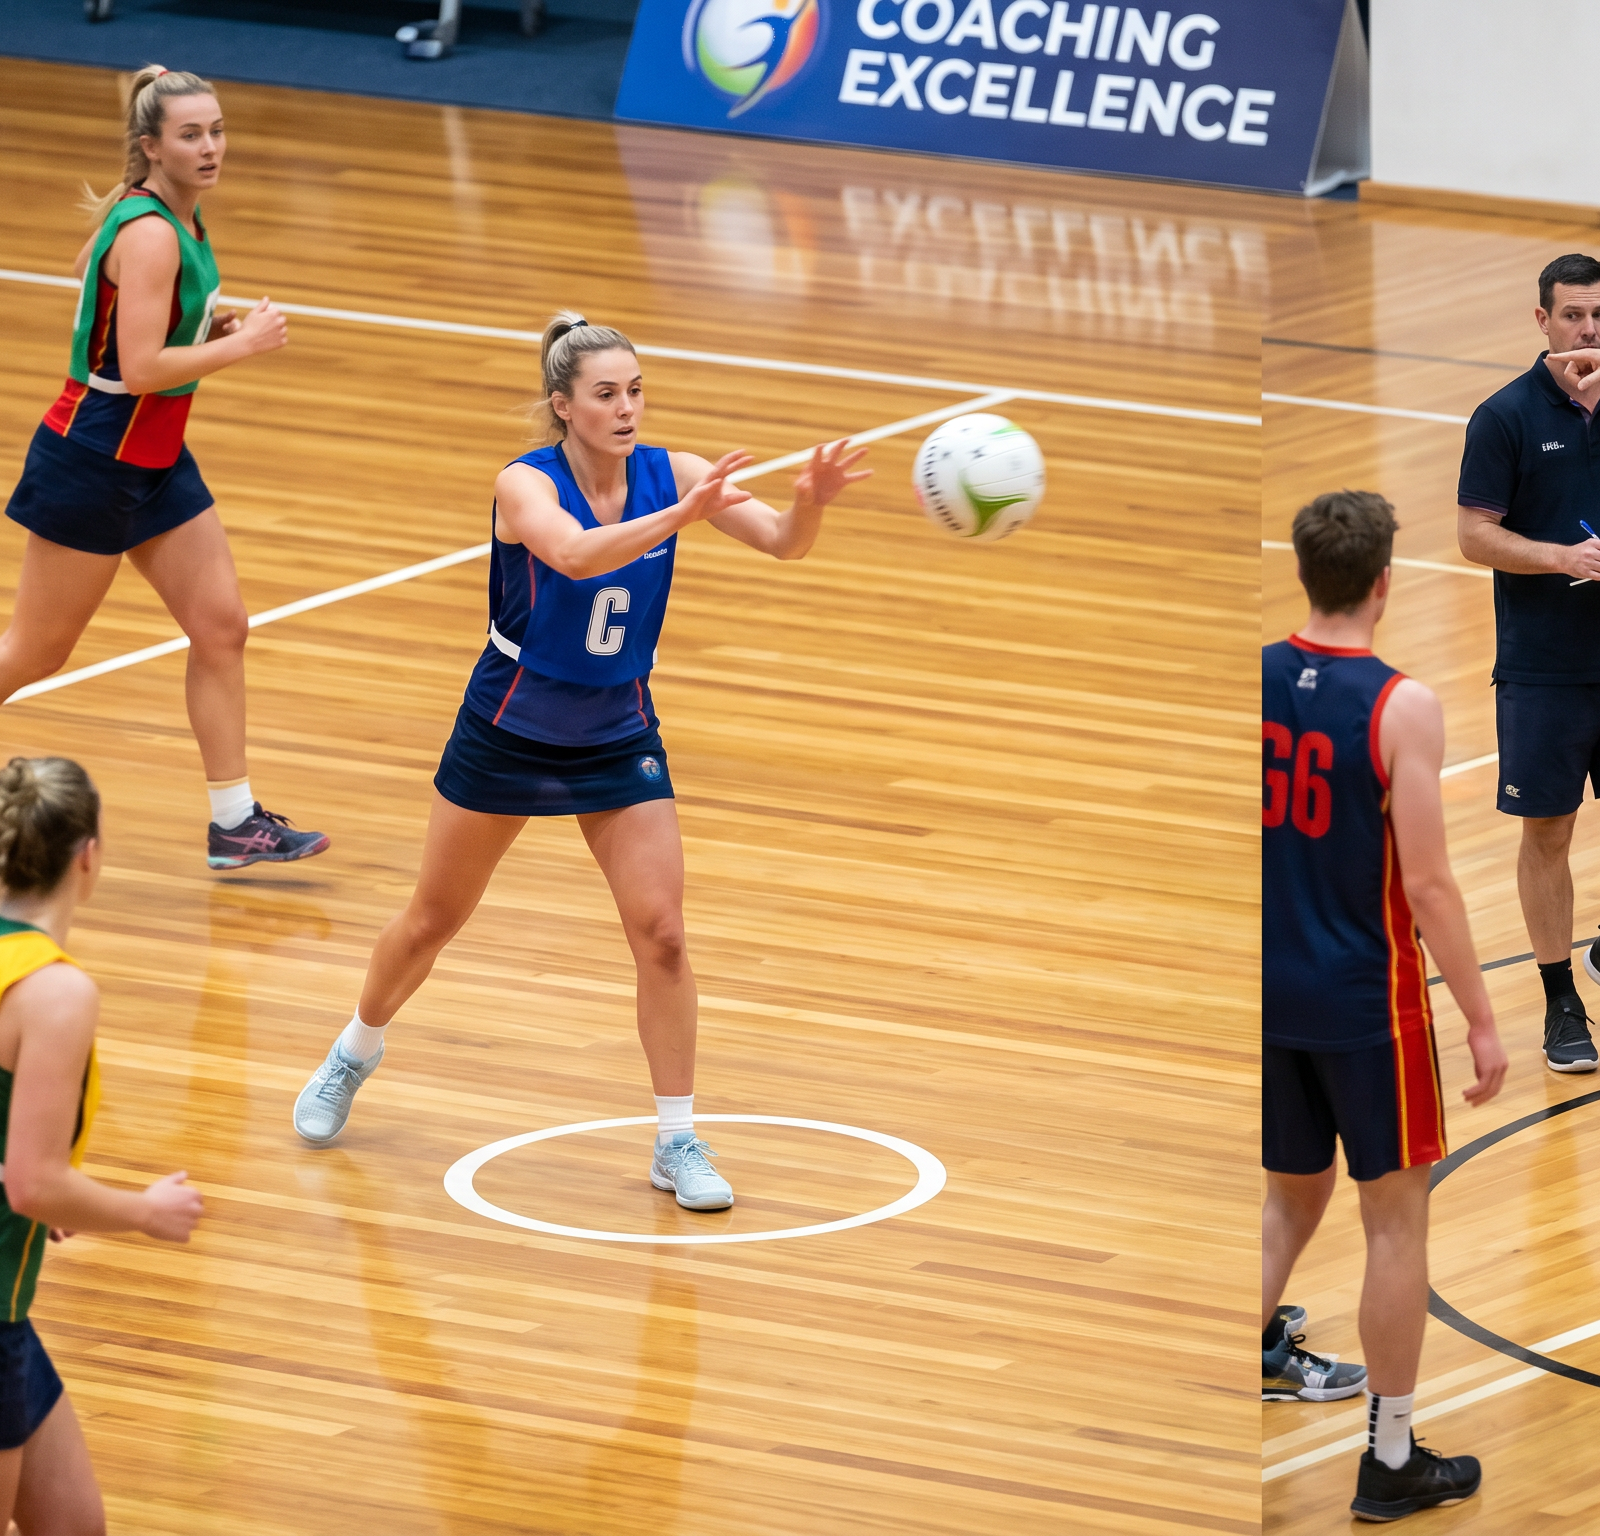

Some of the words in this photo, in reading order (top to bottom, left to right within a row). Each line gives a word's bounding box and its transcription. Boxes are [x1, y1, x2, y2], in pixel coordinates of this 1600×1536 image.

[857, 0, 1221, 71] COACHING
[838, 48, 1276, 146] EXCELLENCE
[585, 586, 631, 656] C
